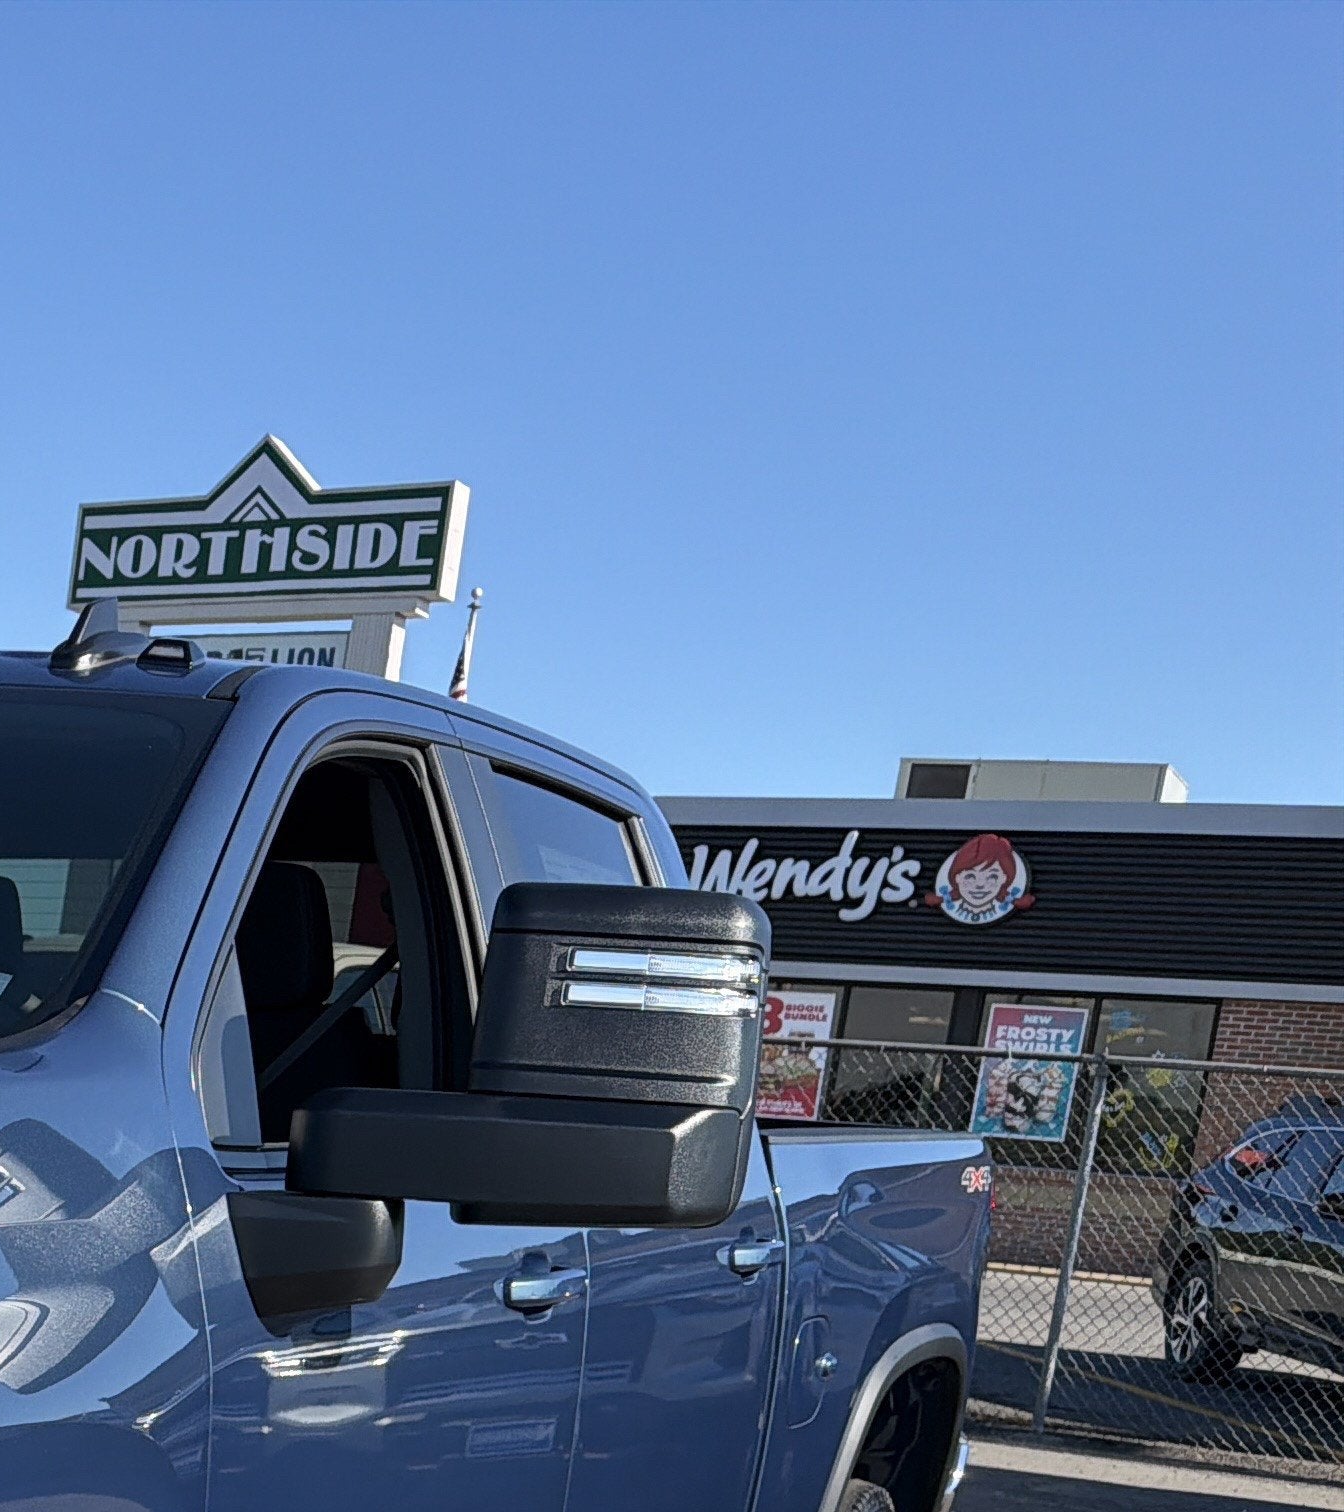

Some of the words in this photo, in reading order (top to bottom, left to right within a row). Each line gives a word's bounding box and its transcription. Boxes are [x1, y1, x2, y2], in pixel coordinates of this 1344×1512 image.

[78, 519, 438, 582] NORTHSIDE
[689, 830, 921, 922] Wendy's
[785, 1003, 827, 1014] BIGGIE
[783, 1012, 829, 1023] BUNDLE
[1023, 1013, 1053, 1025] NEW
[995, 1024, 1075, 1042] FROSTY
